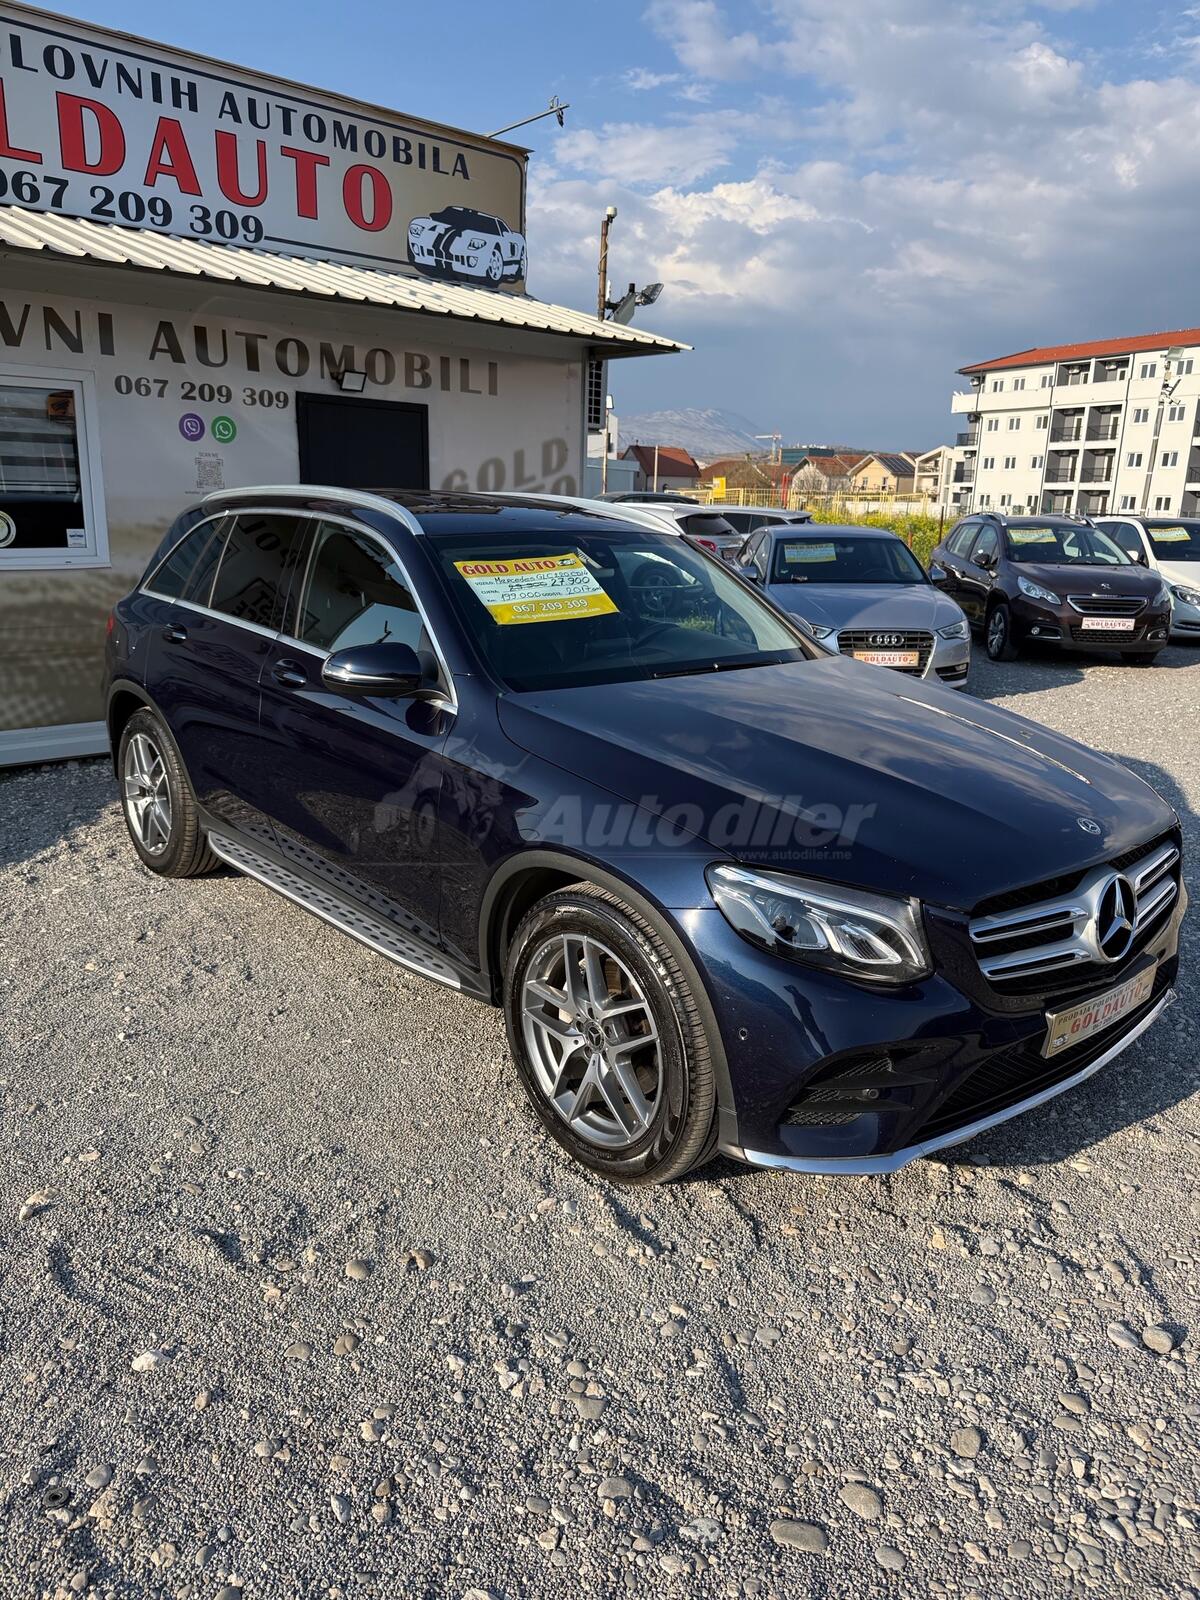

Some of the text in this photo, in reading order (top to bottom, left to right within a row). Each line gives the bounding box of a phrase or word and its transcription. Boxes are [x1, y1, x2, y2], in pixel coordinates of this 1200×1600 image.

[218, 91, 470, 181] AUTOMOBILA
[90, 185, 172, 228] 209
[190, 205, 264, 244] 309
[0, 301, 498, 396] VNI AUTOMOBILI
[114, 374, 289, 409] 067 209 309
[441, 438, 568, 492] GOLD
[462, 560, 556, 575] GOLD AUTO
[495, 576, 536, 585] Mercedes
[512, 599, 588, 613] 067 209 309
[1070, 983, 1143, 1034] GOLDAUTO
